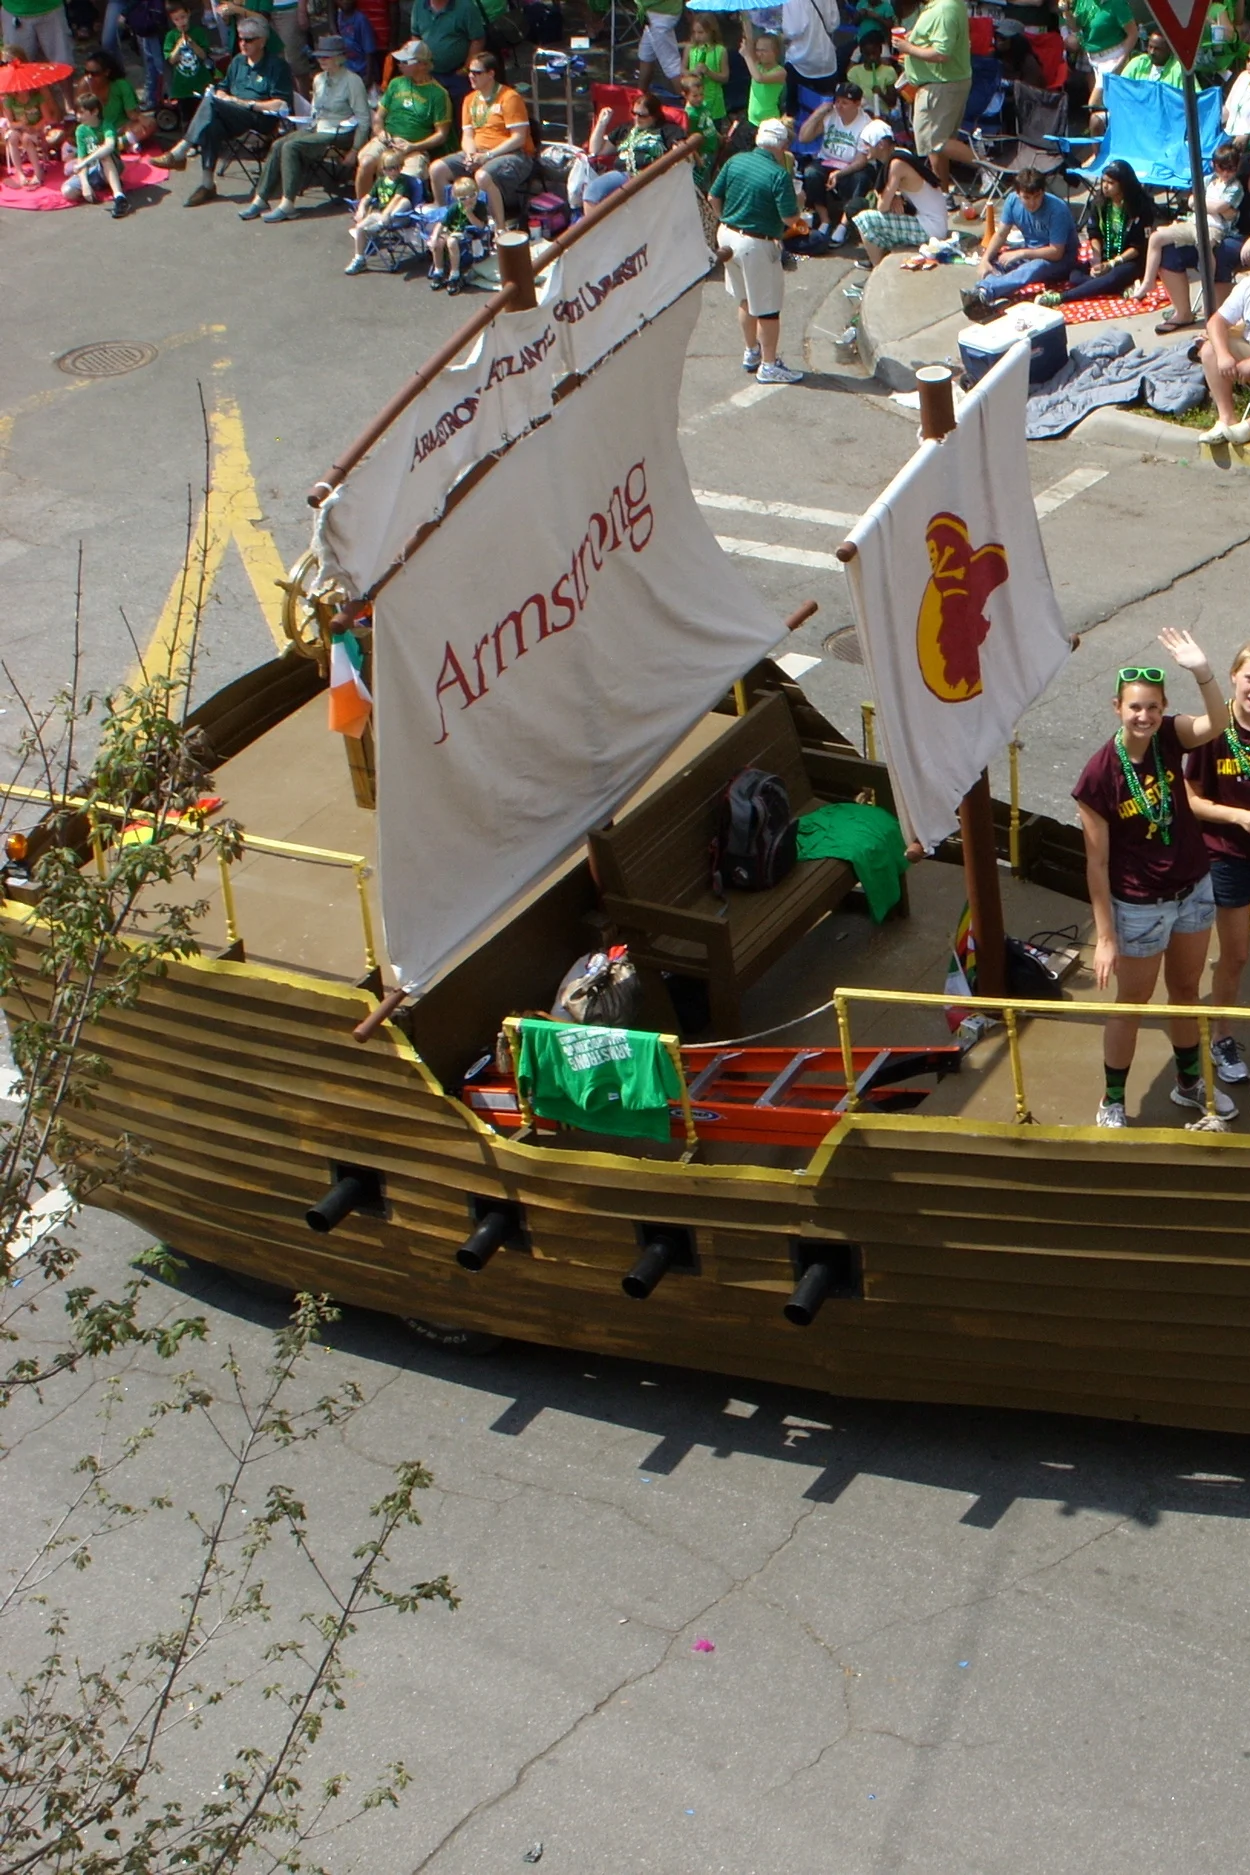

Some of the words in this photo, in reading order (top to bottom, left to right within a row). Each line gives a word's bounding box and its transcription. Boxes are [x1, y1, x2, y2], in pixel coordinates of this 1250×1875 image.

[410, 387, 482, 472] ARMSTRON
[433, 456, 654, 745] Armstrong
[567, 1042, 633, 1072] ARMSTRONG
